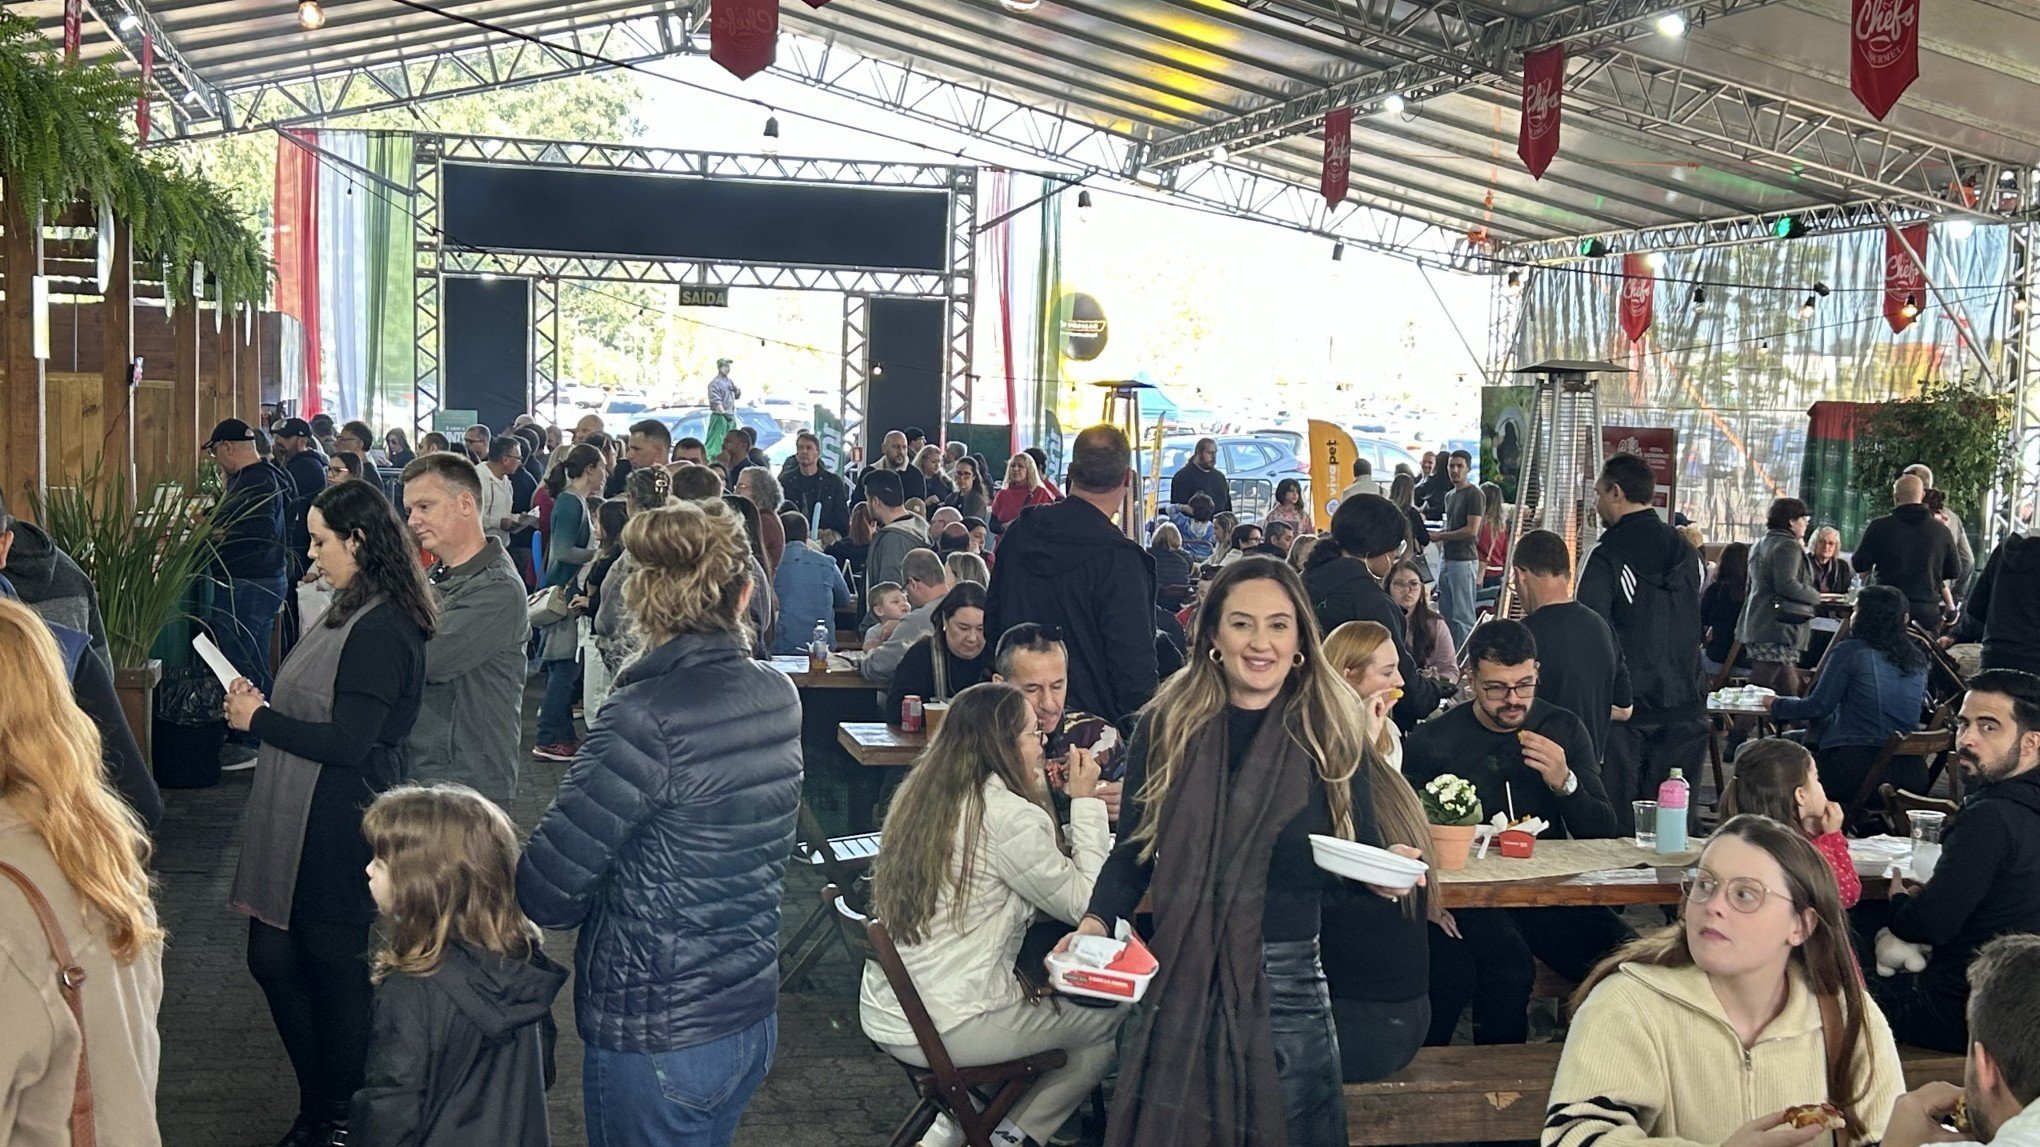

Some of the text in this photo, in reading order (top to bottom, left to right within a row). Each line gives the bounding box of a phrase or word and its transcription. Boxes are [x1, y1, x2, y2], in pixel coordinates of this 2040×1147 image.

[1855, 0, 1915, 40] Chefs
[682, 288, 725, 305] SAÍDA
[1326, 439, 1340, 497] vivapet
